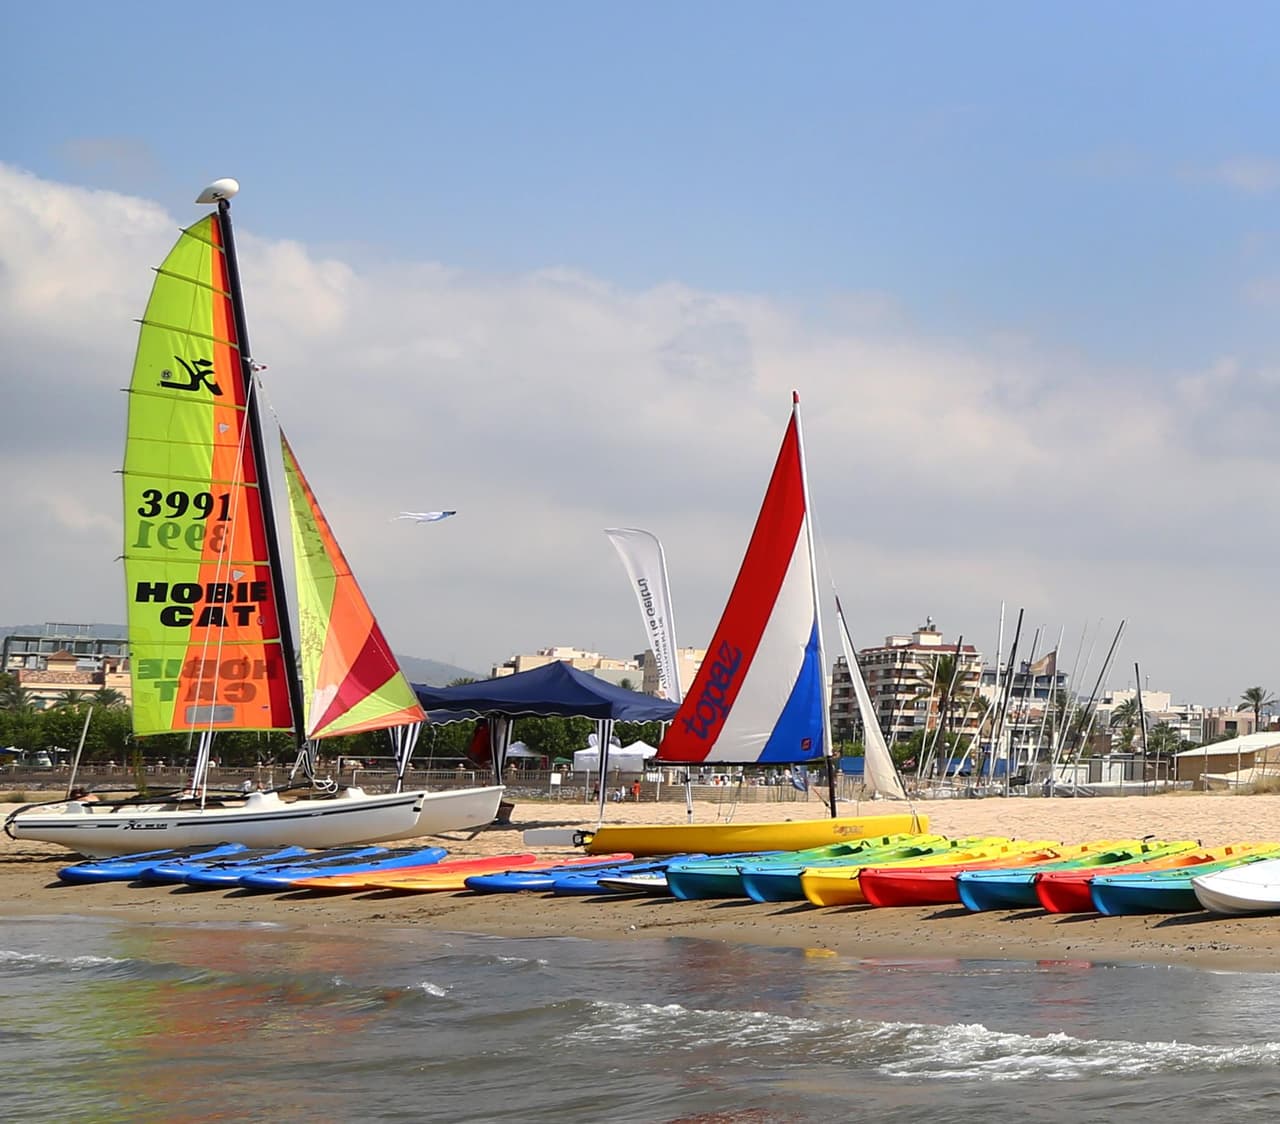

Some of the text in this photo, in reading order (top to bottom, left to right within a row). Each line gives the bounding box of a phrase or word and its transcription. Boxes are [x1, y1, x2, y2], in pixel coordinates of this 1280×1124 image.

[137, 489, 233, 522] 3991
[135, 582, 268, 605] HOBIE
[160, 605, 256, 628] CAT
[682, 639, 744, 740] topaz
